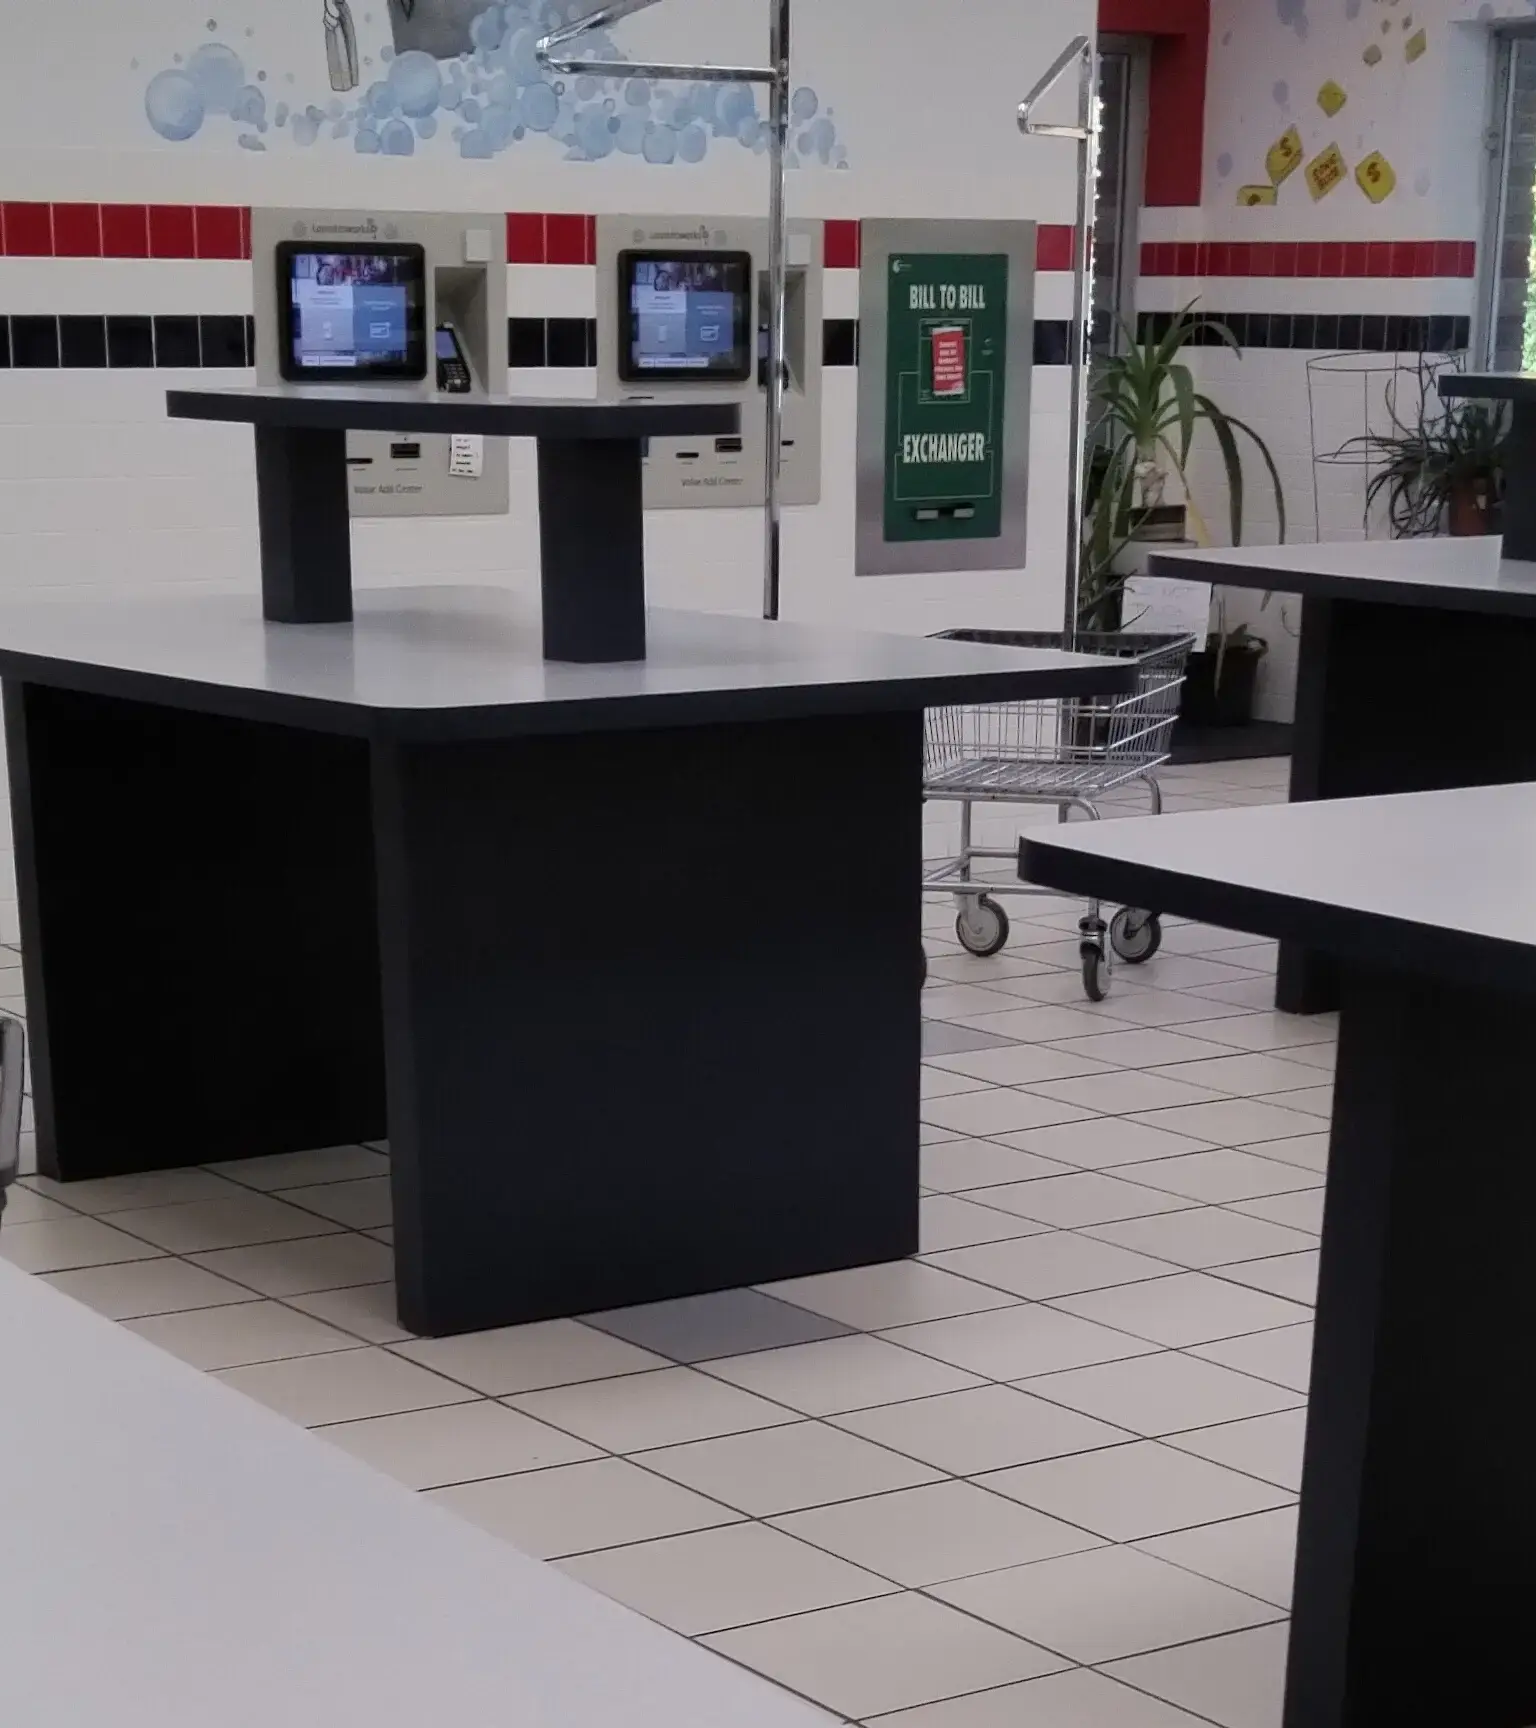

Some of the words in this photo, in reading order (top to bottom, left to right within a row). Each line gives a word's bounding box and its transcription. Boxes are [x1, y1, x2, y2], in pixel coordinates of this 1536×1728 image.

[909, 284, 936, 310] BILL
[939, 284, 956, 310] TO
[959, 284, 986, 310] BILL
[903, 432, 985, 464] EXCHANGER
